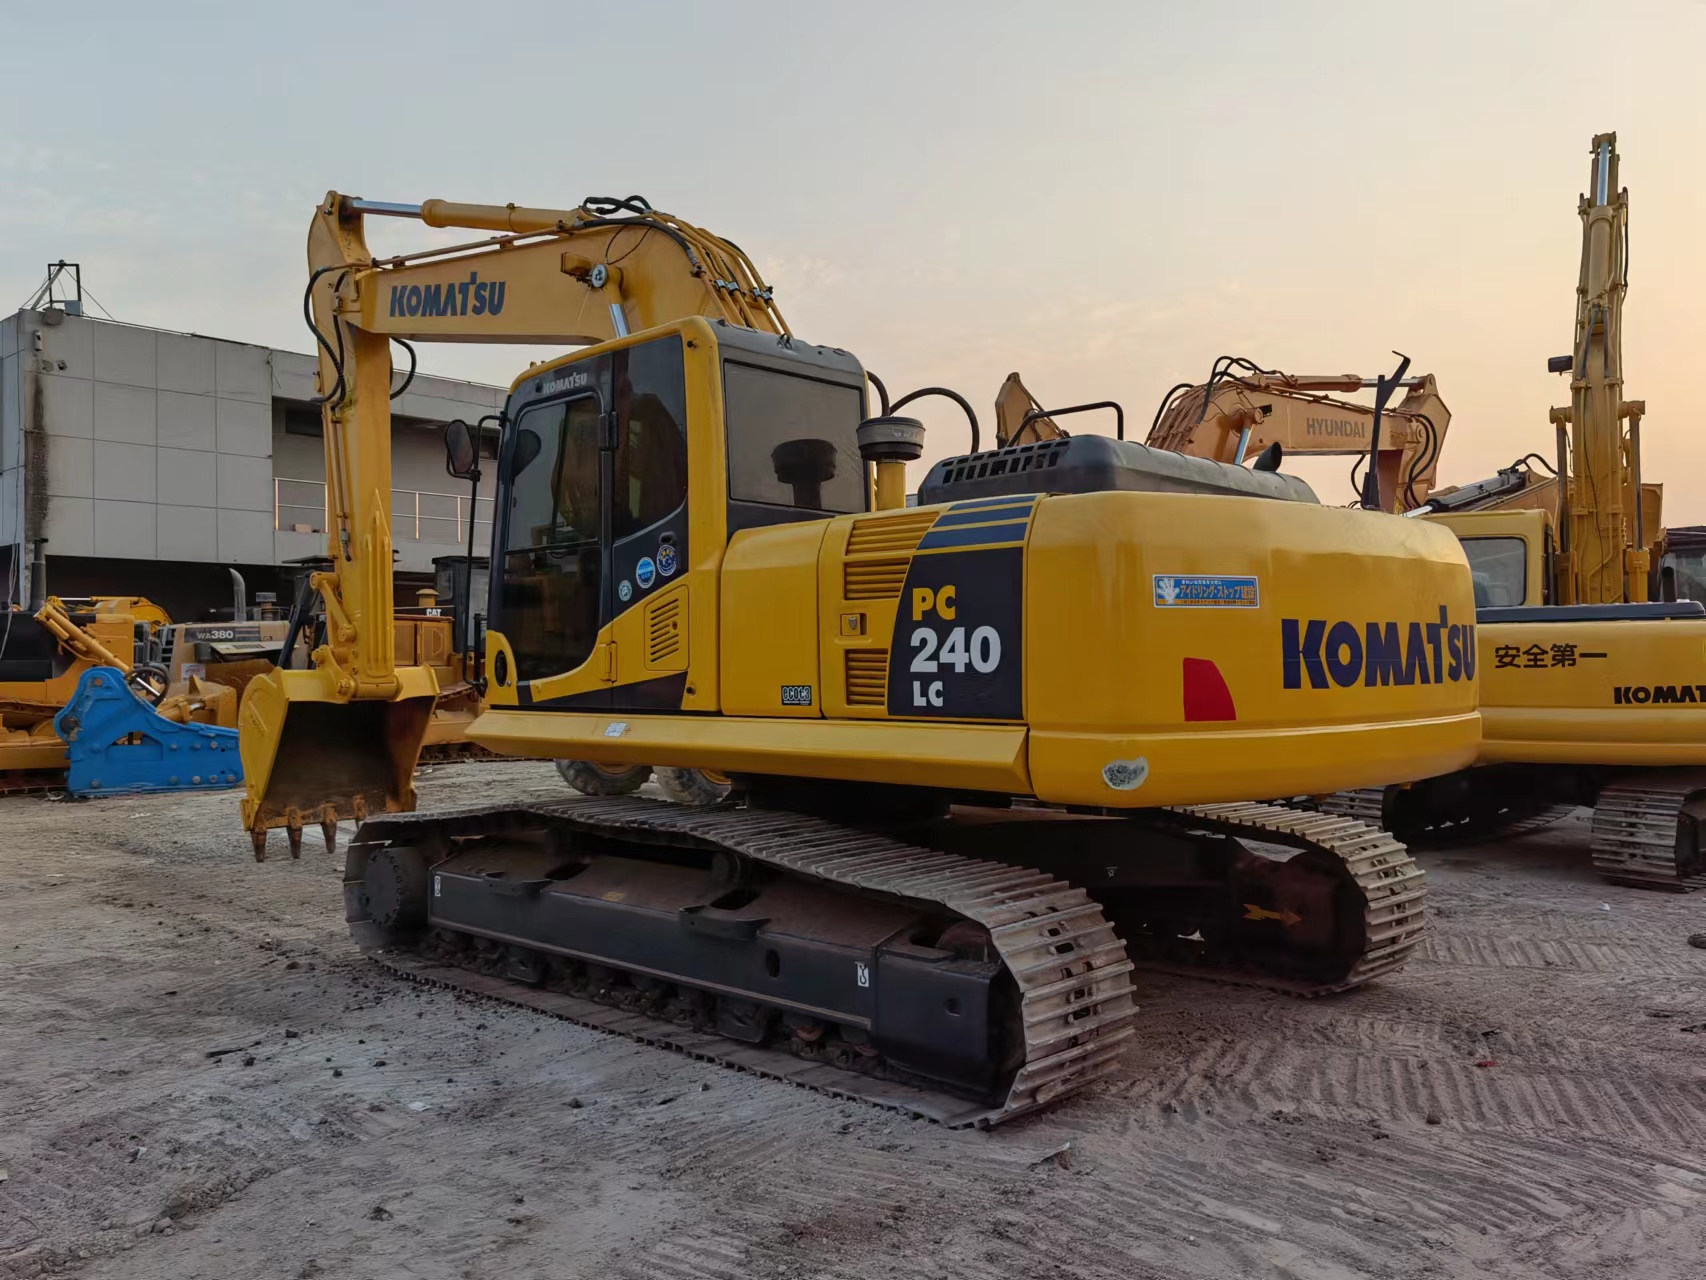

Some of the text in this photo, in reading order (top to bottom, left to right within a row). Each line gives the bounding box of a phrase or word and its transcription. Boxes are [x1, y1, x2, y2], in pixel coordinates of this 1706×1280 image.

[389, 272, 505, 317] KOMATSU
[543, 372, 588, 394] KOMATSU
[1306, 417, 1365, 438] HYUNDAI
[426, 608, 442, 617] CAT
[912, 585, 956, 621] PC
[197, 630, 234, 640] WA380
[1281, 605, 1476, 689] KOMATSU
[910, 625, 1001, 674] 240
[1494, 643, 1608, 669] 安全第一
[912, 680, 944, 707] LC
